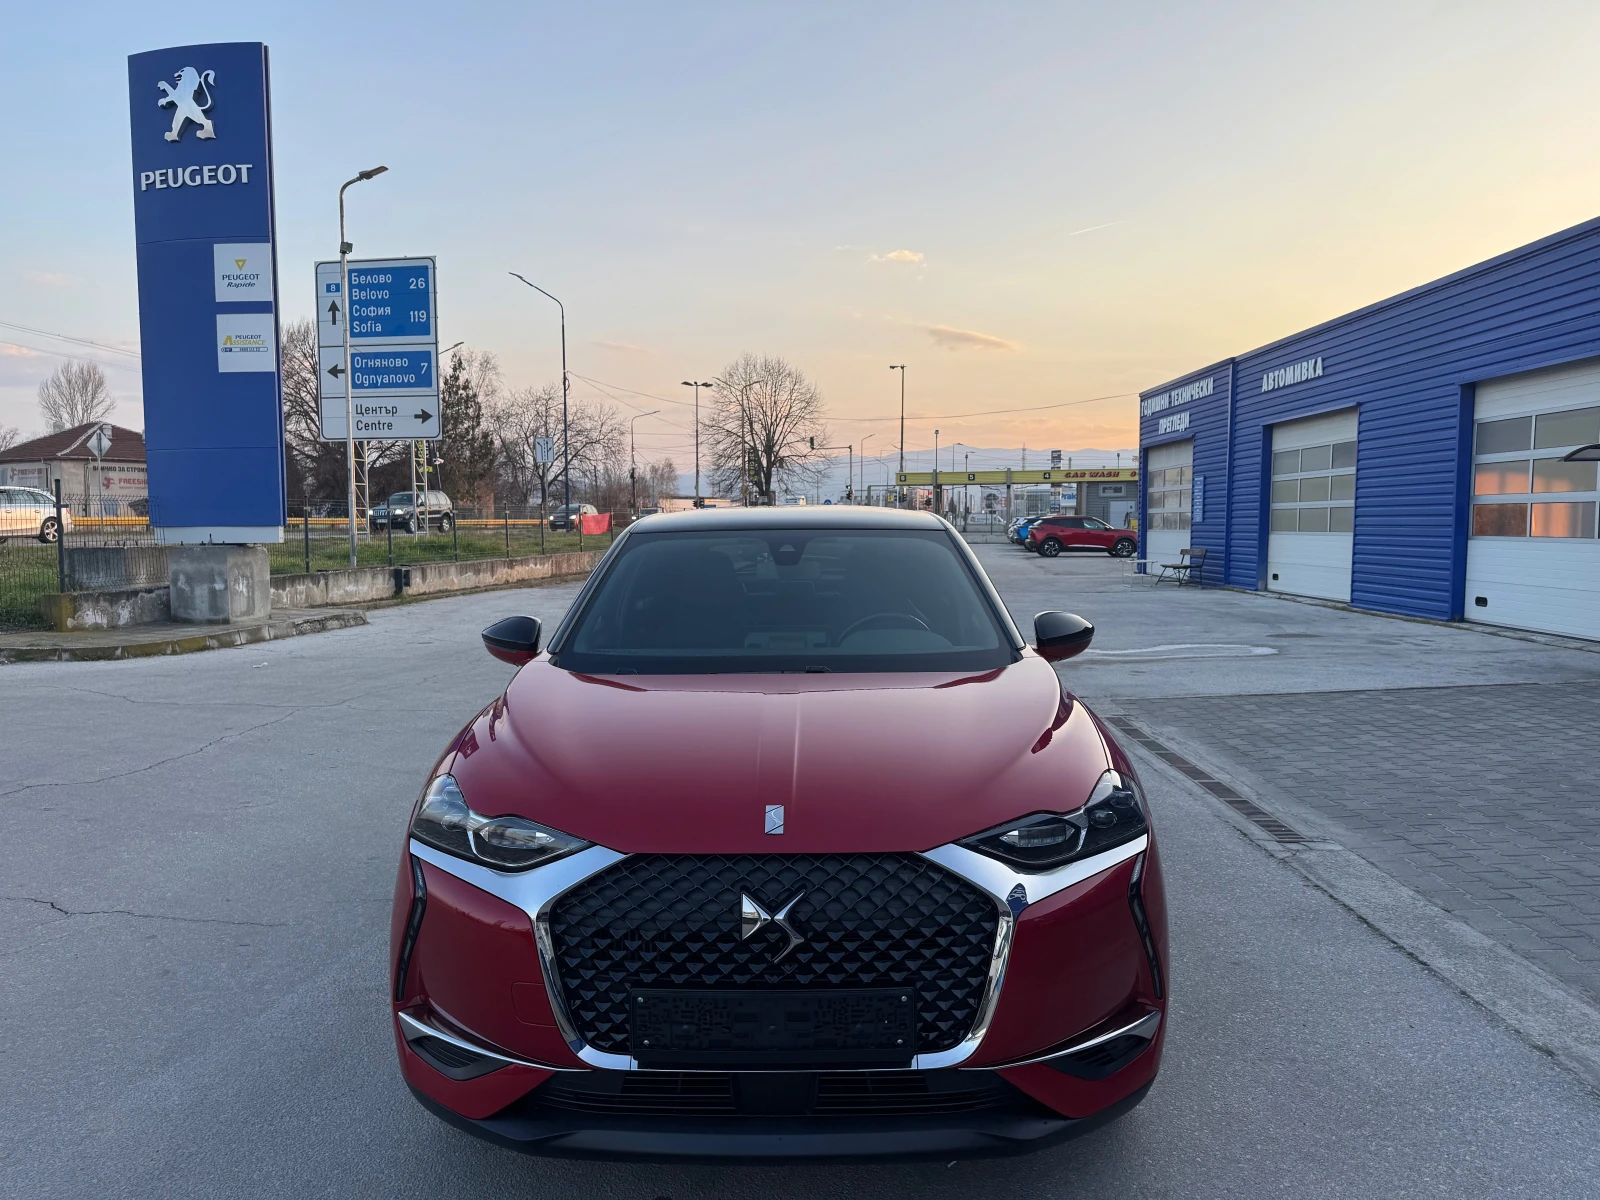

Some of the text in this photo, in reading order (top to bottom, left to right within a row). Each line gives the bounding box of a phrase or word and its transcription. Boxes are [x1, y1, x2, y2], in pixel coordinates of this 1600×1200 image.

[140, 164, 253, 191] PEUGEOT
[222, 273, 260, 281] PEUGEOT
[351, 272, 392, 285] Белово
[409, 277, 426, 290] 26
[226, 281, 256, 289] Rapide
[330, 284, 336, 292] 8
[352, 287, 390, 300] Belovo
[352, 304, 391, 317] София
[409, 310, 427, 323] 119
[353, 320, 382, 333] Sofia
[354, 356, 409, 368] Огняново
[420, 362, 428, 375] 7
[355, 372, 416, 387] Ognyanovo
[1261, 356, 1324, 393] АВТОМИВКА
[1141, 376, 1214, 417] ГОДИШНИ ТЕХНИЧЕСКИ
[355, 403, 398, 417] Център
[356, 419, 393, 431] Centre
[1158, 411, 1190, 435] ПРЕГЛЕДИ
